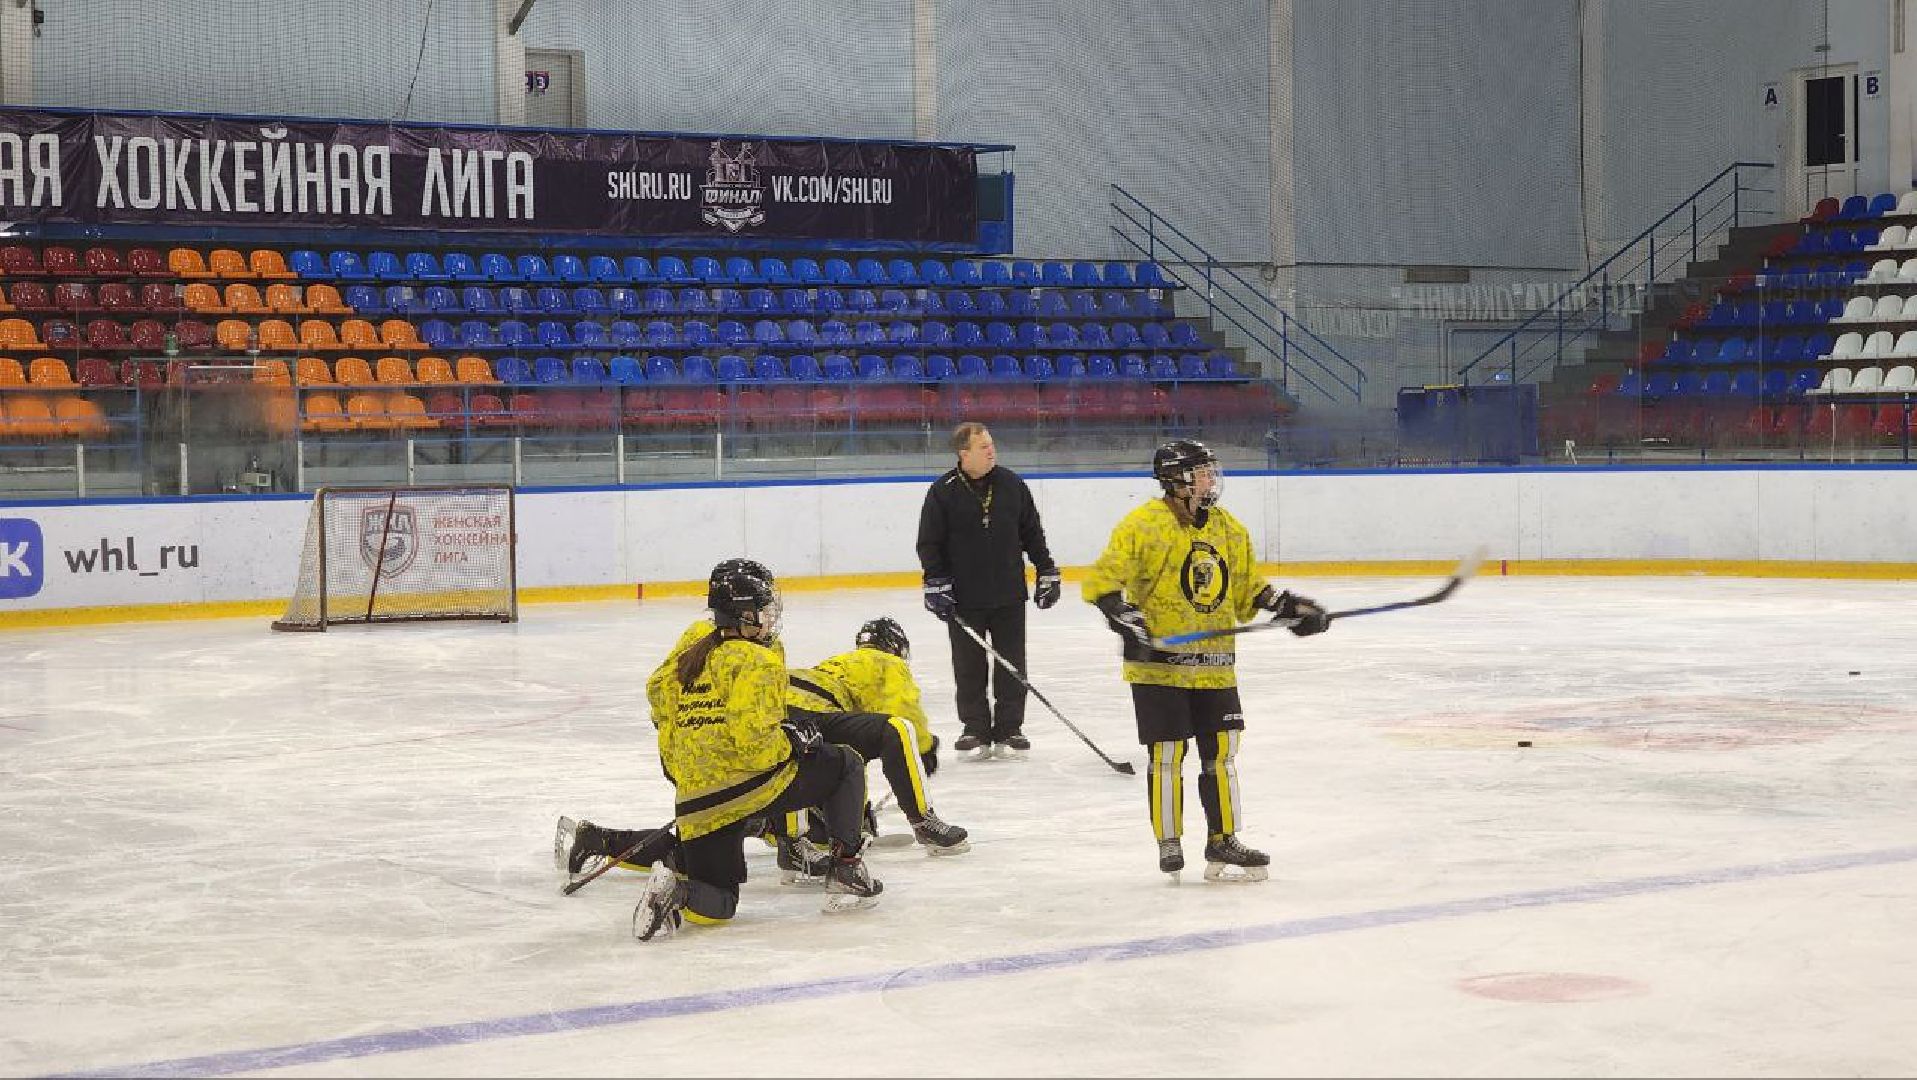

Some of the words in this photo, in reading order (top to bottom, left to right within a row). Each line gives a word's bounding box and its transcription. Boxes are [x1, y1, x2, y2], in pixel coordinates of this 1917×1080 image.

[0, 132, 62, 207] АЯ
[94, 127, 393, 216] ХОККЕЙНАЯ
[421, 147, 535, 220] ЛИГА
[608, 171, 691, 200] SHLRU.RU
[705, 189, 761, 204] ФИНАЛ
[771, 175, 892, 204] VK.COM/SHLRU
[64, 536, 199, 577] whl_ru
[433, 551, 468, 563] ЛИГА
